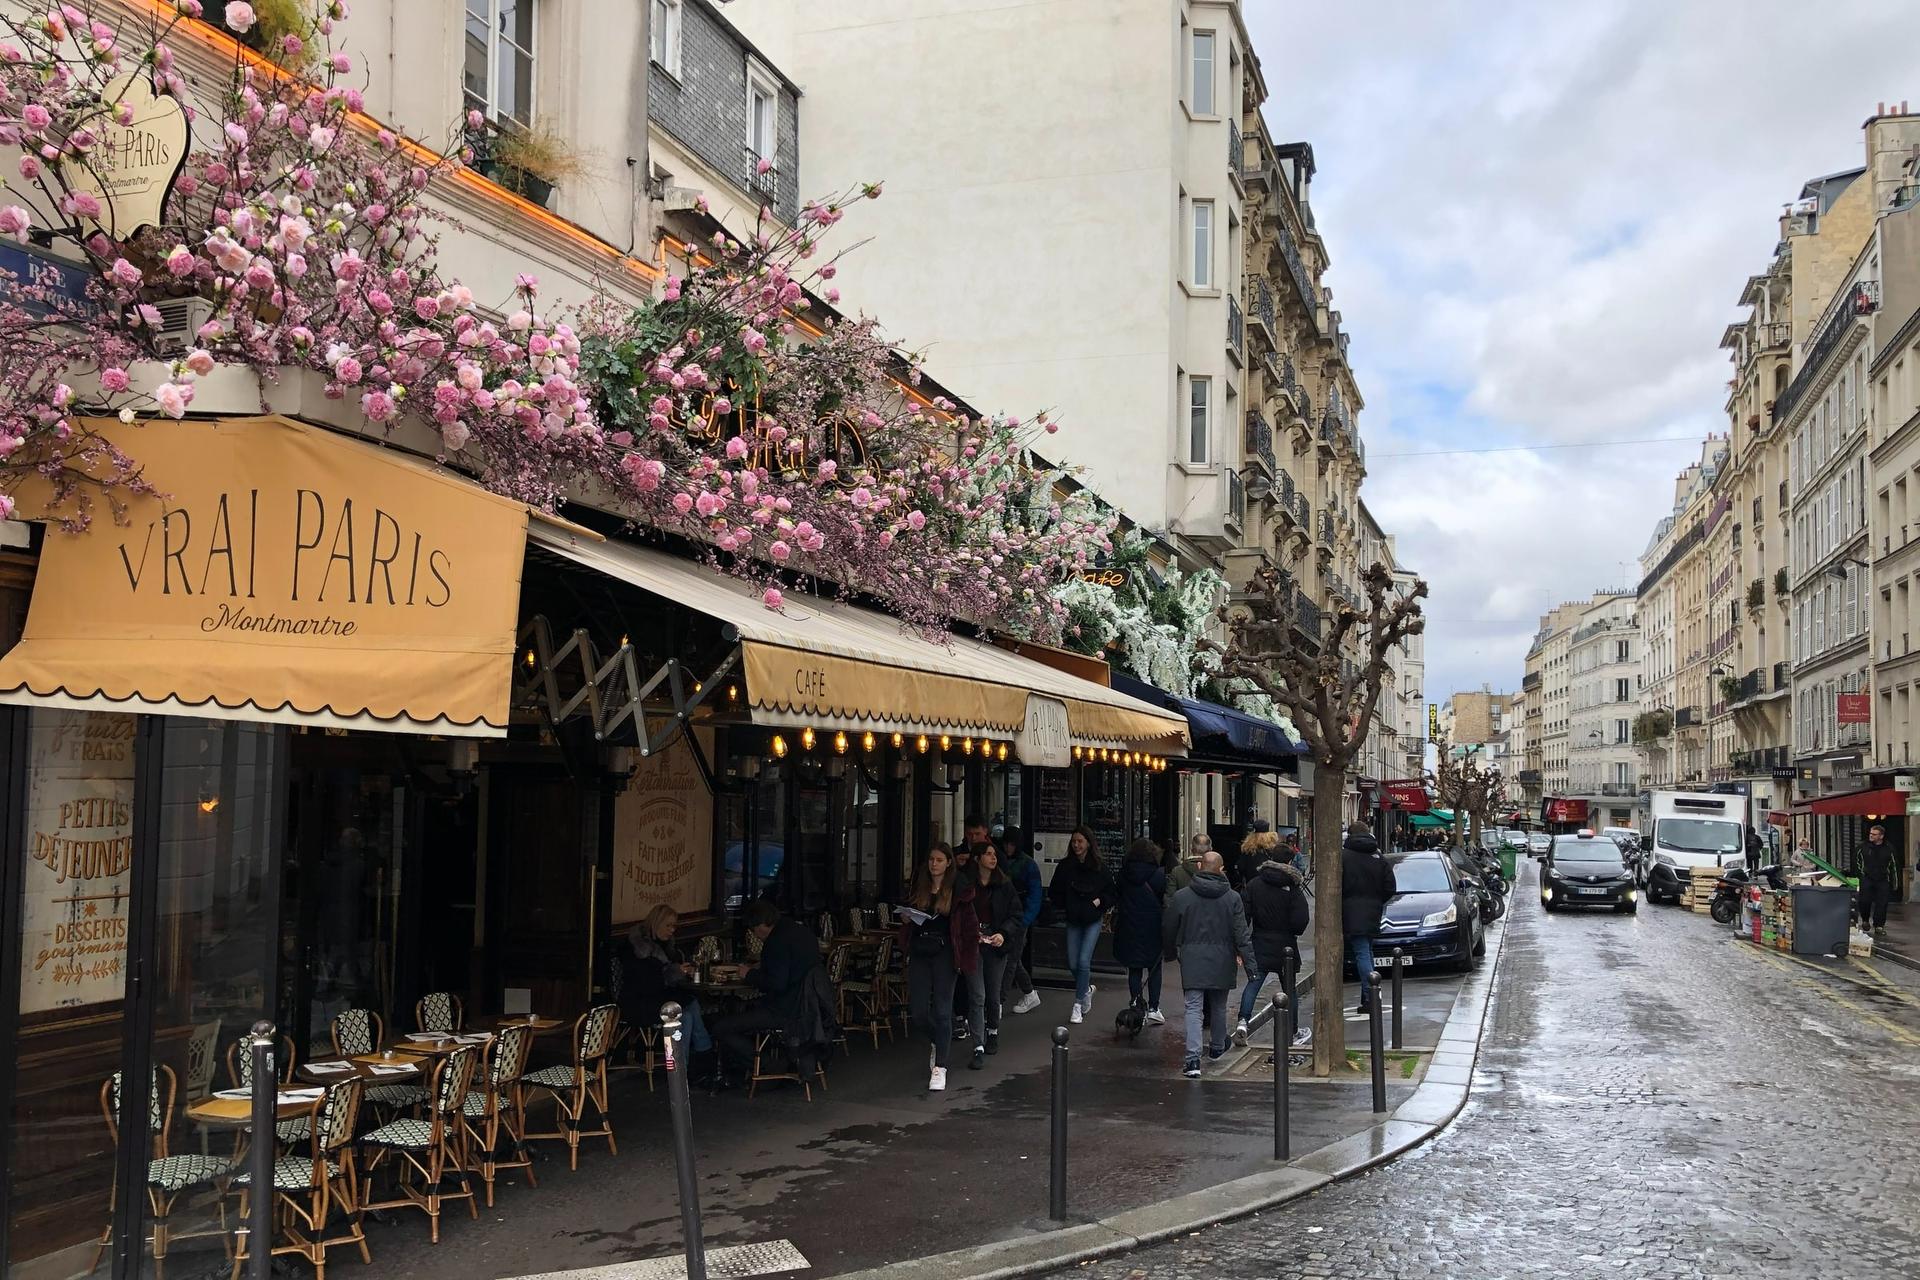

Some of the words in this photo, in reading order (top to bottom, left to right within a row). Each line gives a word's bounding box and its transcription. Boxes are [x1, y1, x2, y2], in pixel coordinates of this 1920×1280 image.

[124, 129, 169, 169] PARIS
[94, 176, 149, 192] ontmartre
[28, 262, 66, 288] RE
[118, 489, 258, 598] VRAI
[291, 488, 451, 607] PARIS
[201, 603, 358, 636] Montmartre
[796, 668, 825, 697] CAFÉ
[70, 740, 124, 761] FRAIS
[58, 798, 129, 829] PETITS
[639, 840, 657, 863] FAIT
[657, 838, 686, 864] MAISON
[635, 865, 666, 887] TOUTE
[667, 854, 696, 884] HEURE
[56, 918, 126, 944] DESSERTS
[34, 942, 126, 971] gourman
